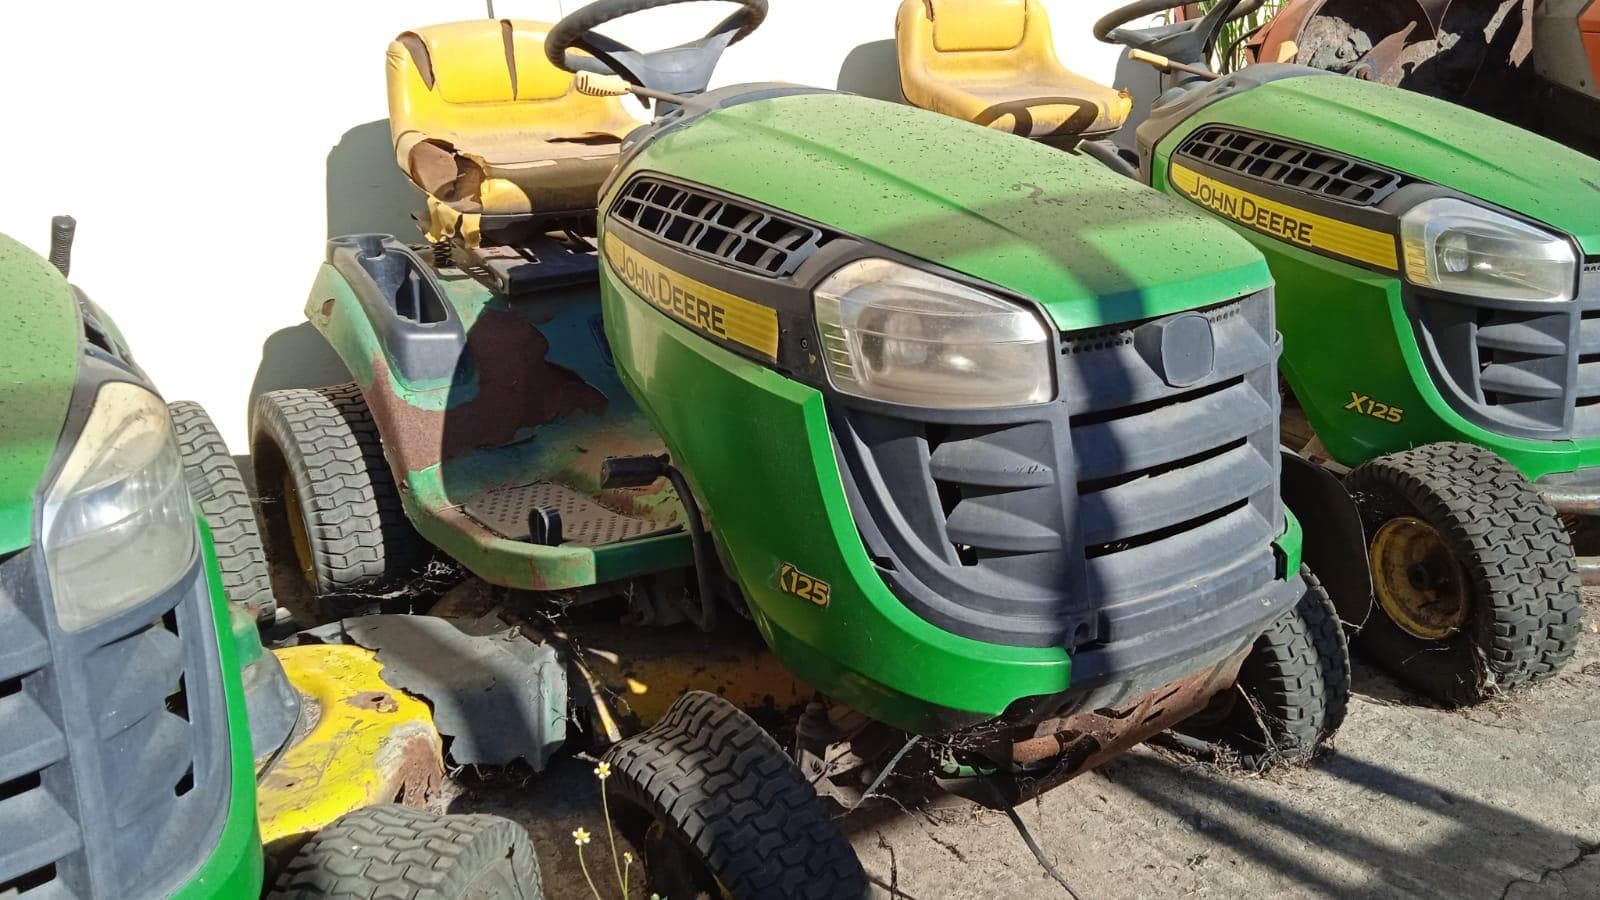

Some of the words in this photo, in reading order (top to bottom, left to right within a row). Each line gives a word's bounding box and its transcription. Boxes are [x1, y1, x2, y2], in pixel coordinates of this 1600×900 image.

[1190, 176, 1237, 218] JOHN
[1241, 197, 1313, 244] DEERE
[620, 246, 656, 299] JOHN
[659, 273, 726, 335] DEERE
[1344, 391, 1404, 423] X125
